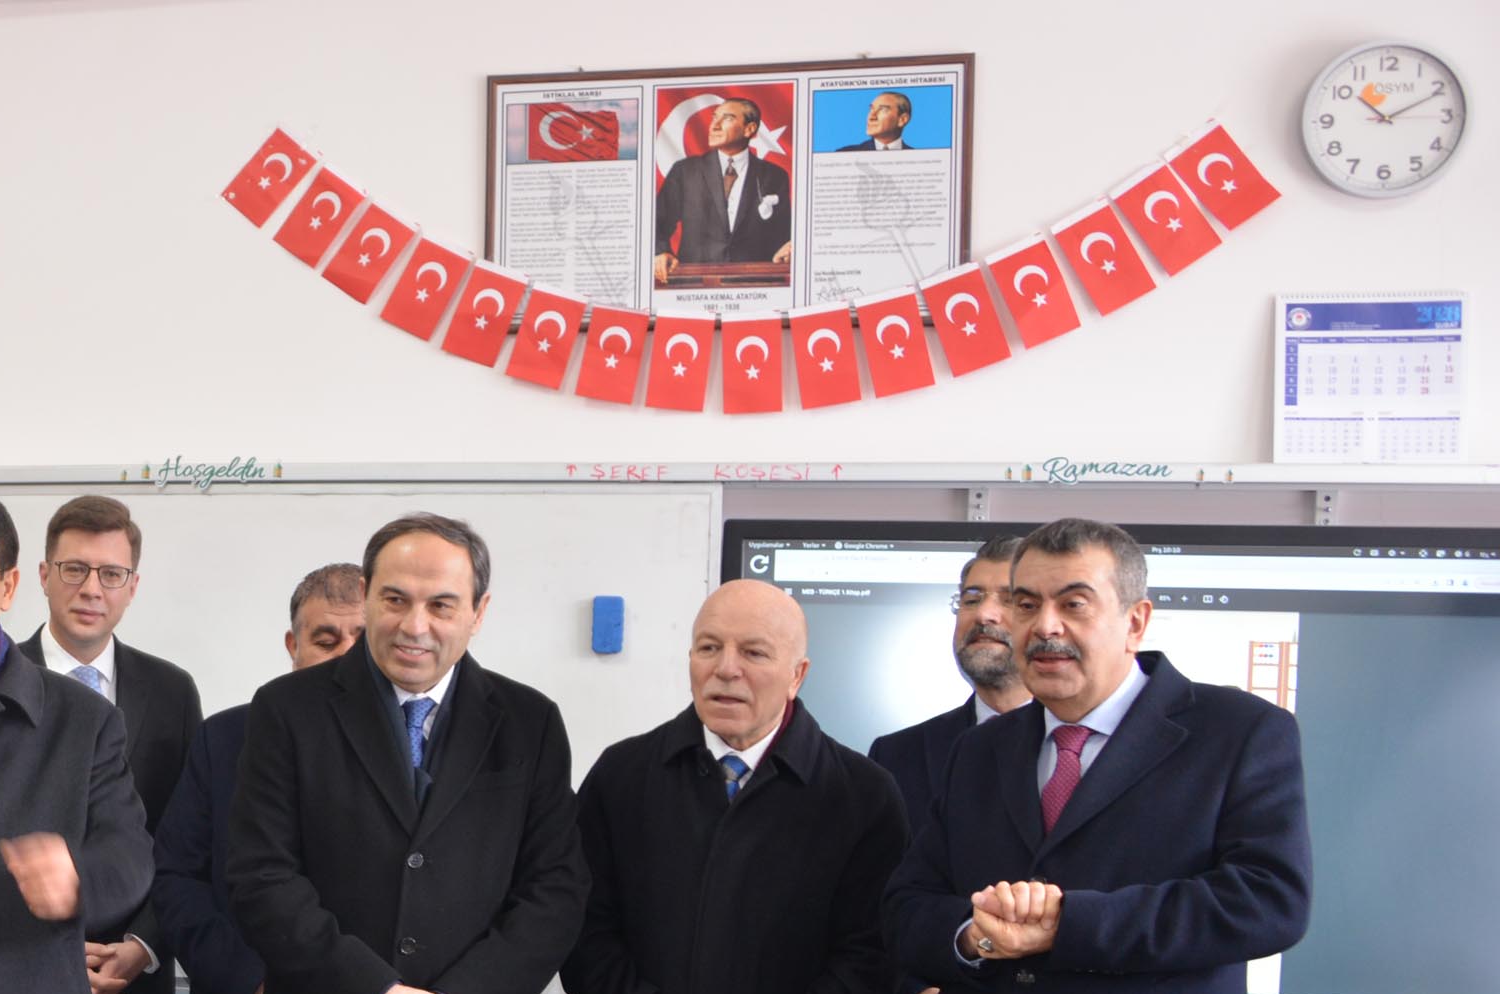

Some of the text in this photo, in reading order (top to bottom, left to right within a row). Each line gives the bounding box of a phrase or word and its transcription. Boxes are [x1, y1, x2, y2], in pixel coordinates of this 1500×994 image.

[1379, 56, 1399, 72] 12
[1352, 65, 1366, 81] 11
[1332, 85, 1353, 100] 10
[1431, 81, 1446, 96] 2
[1319, 113, 1335, 129] 9
[1440, 108, 1454, 124] 3
[1326, 140, 1342, 156] 8
[1429, 136, 1444, 152] 4
[1346, 158, 1361, 174] 7
[1409, 155, 1423, 172] 5
[1376, 165, 1392, 180] 6
[590, 463, 669, 481] ŞEREF
[1042, 456, 1172, 484] Ramazan
[844, 542, 888, 550] Google Chrome
